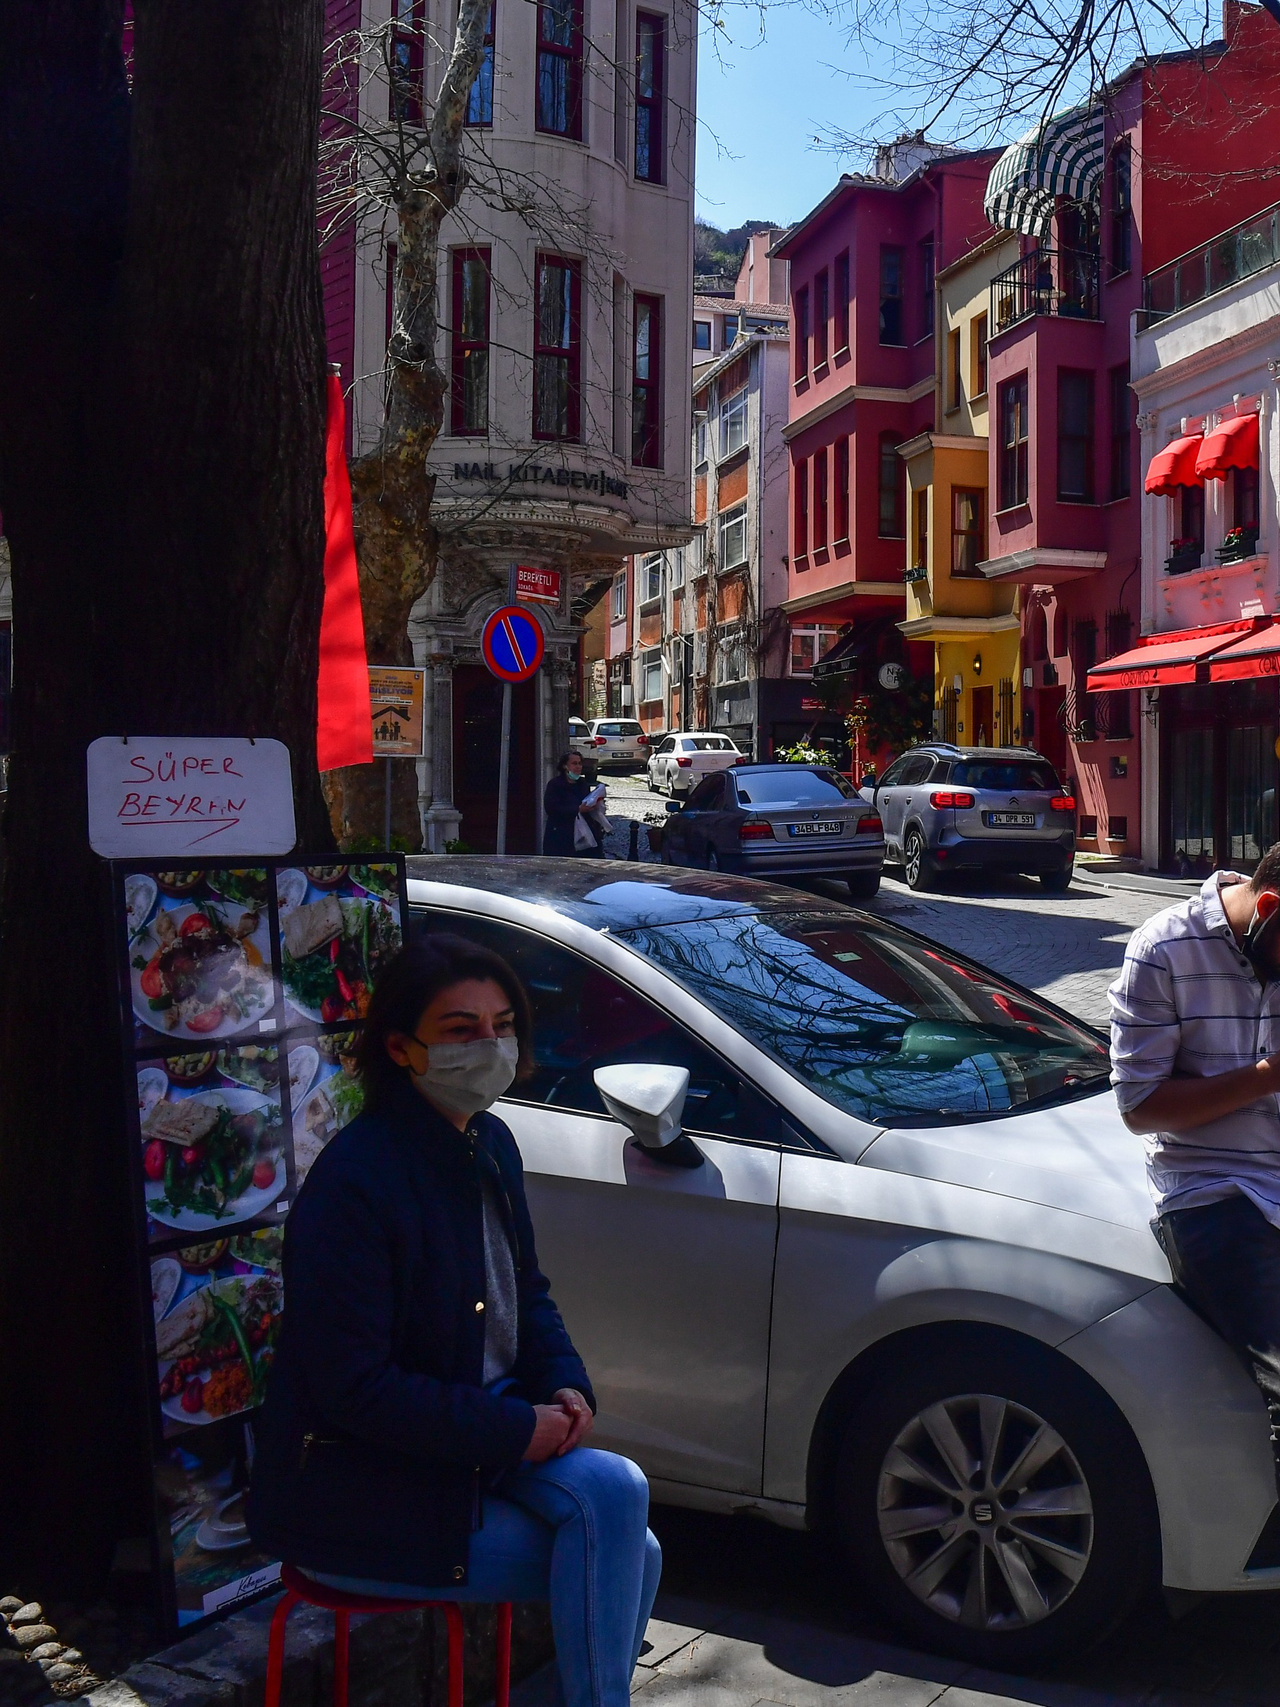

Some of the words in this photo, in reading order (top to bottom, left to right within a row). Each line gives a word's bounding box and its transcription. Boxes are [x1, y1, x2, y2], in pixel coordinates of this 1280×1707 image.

[1120, 670, 1150, 687] CORVINO
[122, 752, 243, 783] SÜPER
[117, 793, 246, 817] BEYRAN
